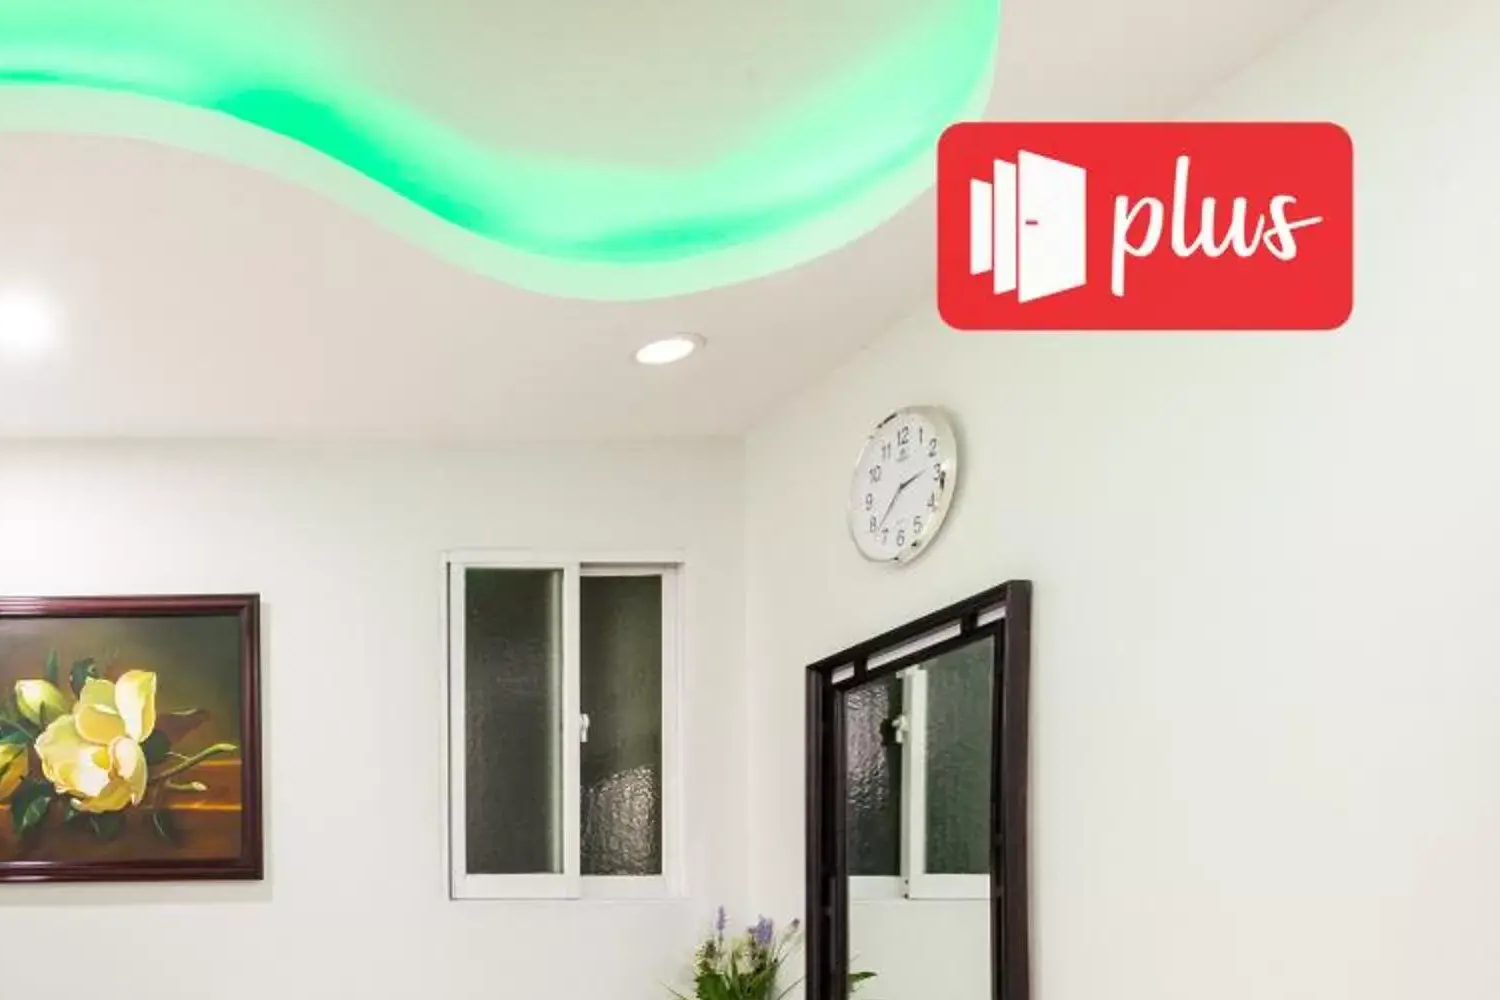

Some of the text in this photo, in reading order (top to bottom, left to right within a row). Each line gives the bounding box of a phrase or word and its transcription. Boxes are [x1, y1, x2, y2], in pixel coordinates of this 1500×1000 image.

[897, 426, 910, 446] 12
[918, 426, 924, 445] 1
[881, 443, 892, 460] 11
[928, 438, 938, 457] 2
[869, 465, 882, 483] 10
[933, 463, 942, 481] 3
[865, 493, 873, 511] 9
[869, 516, 877, 533] 8
[913, 516, 924, 534] 5
[881, 528, 890, 545] 7
[896, 530, 906, 547] 6
